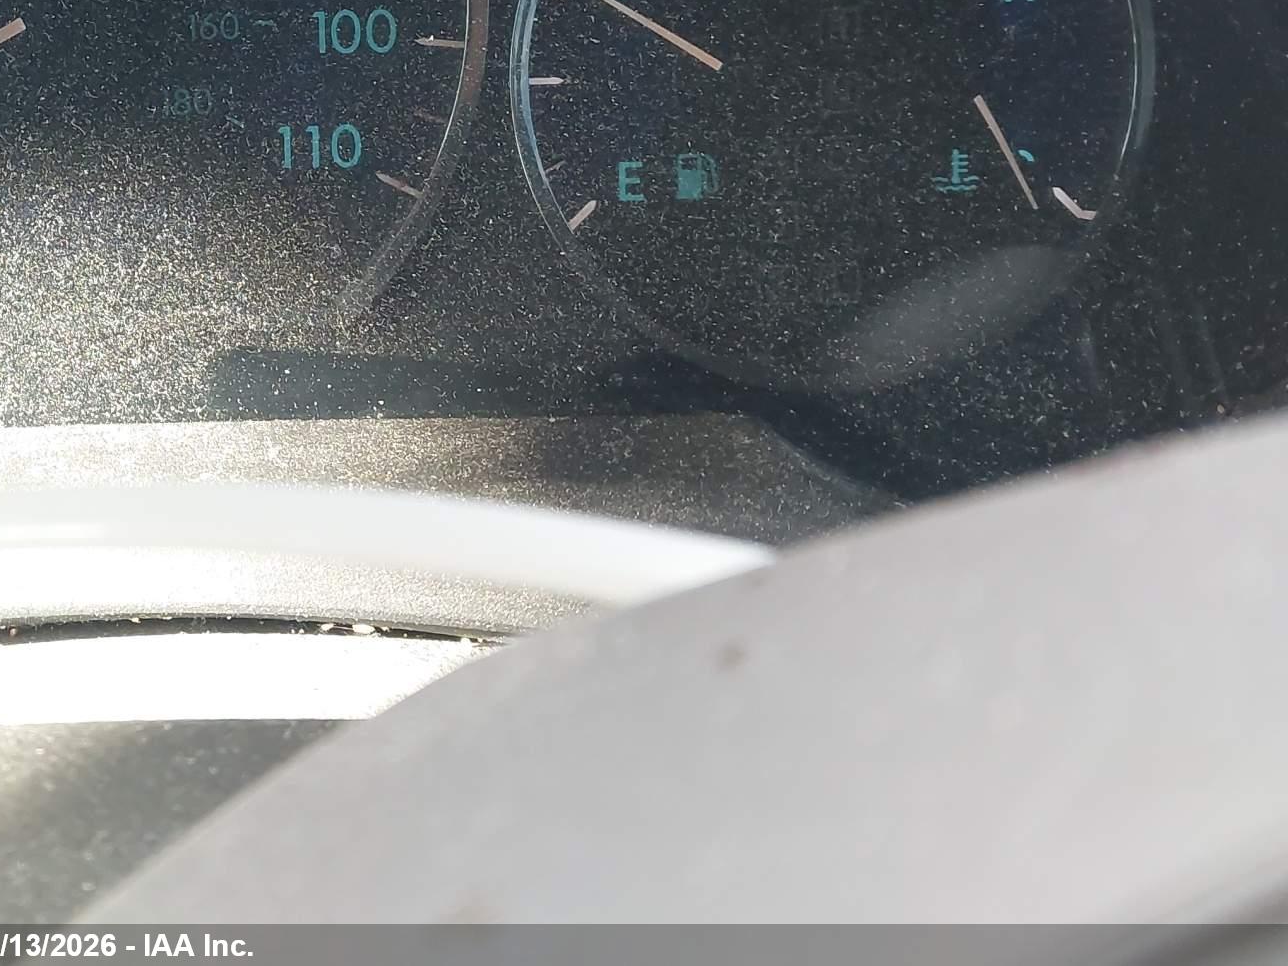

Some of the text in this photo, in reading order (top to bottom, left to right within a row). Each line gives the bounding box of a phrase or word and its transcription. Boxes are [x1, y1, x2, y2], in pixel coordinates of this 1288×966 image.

[188, 12, 239, 41] 160
[313, 9, 397, 54] 100
[279, 124, 361, 168] 110
[618, 162, 644, 201] E
